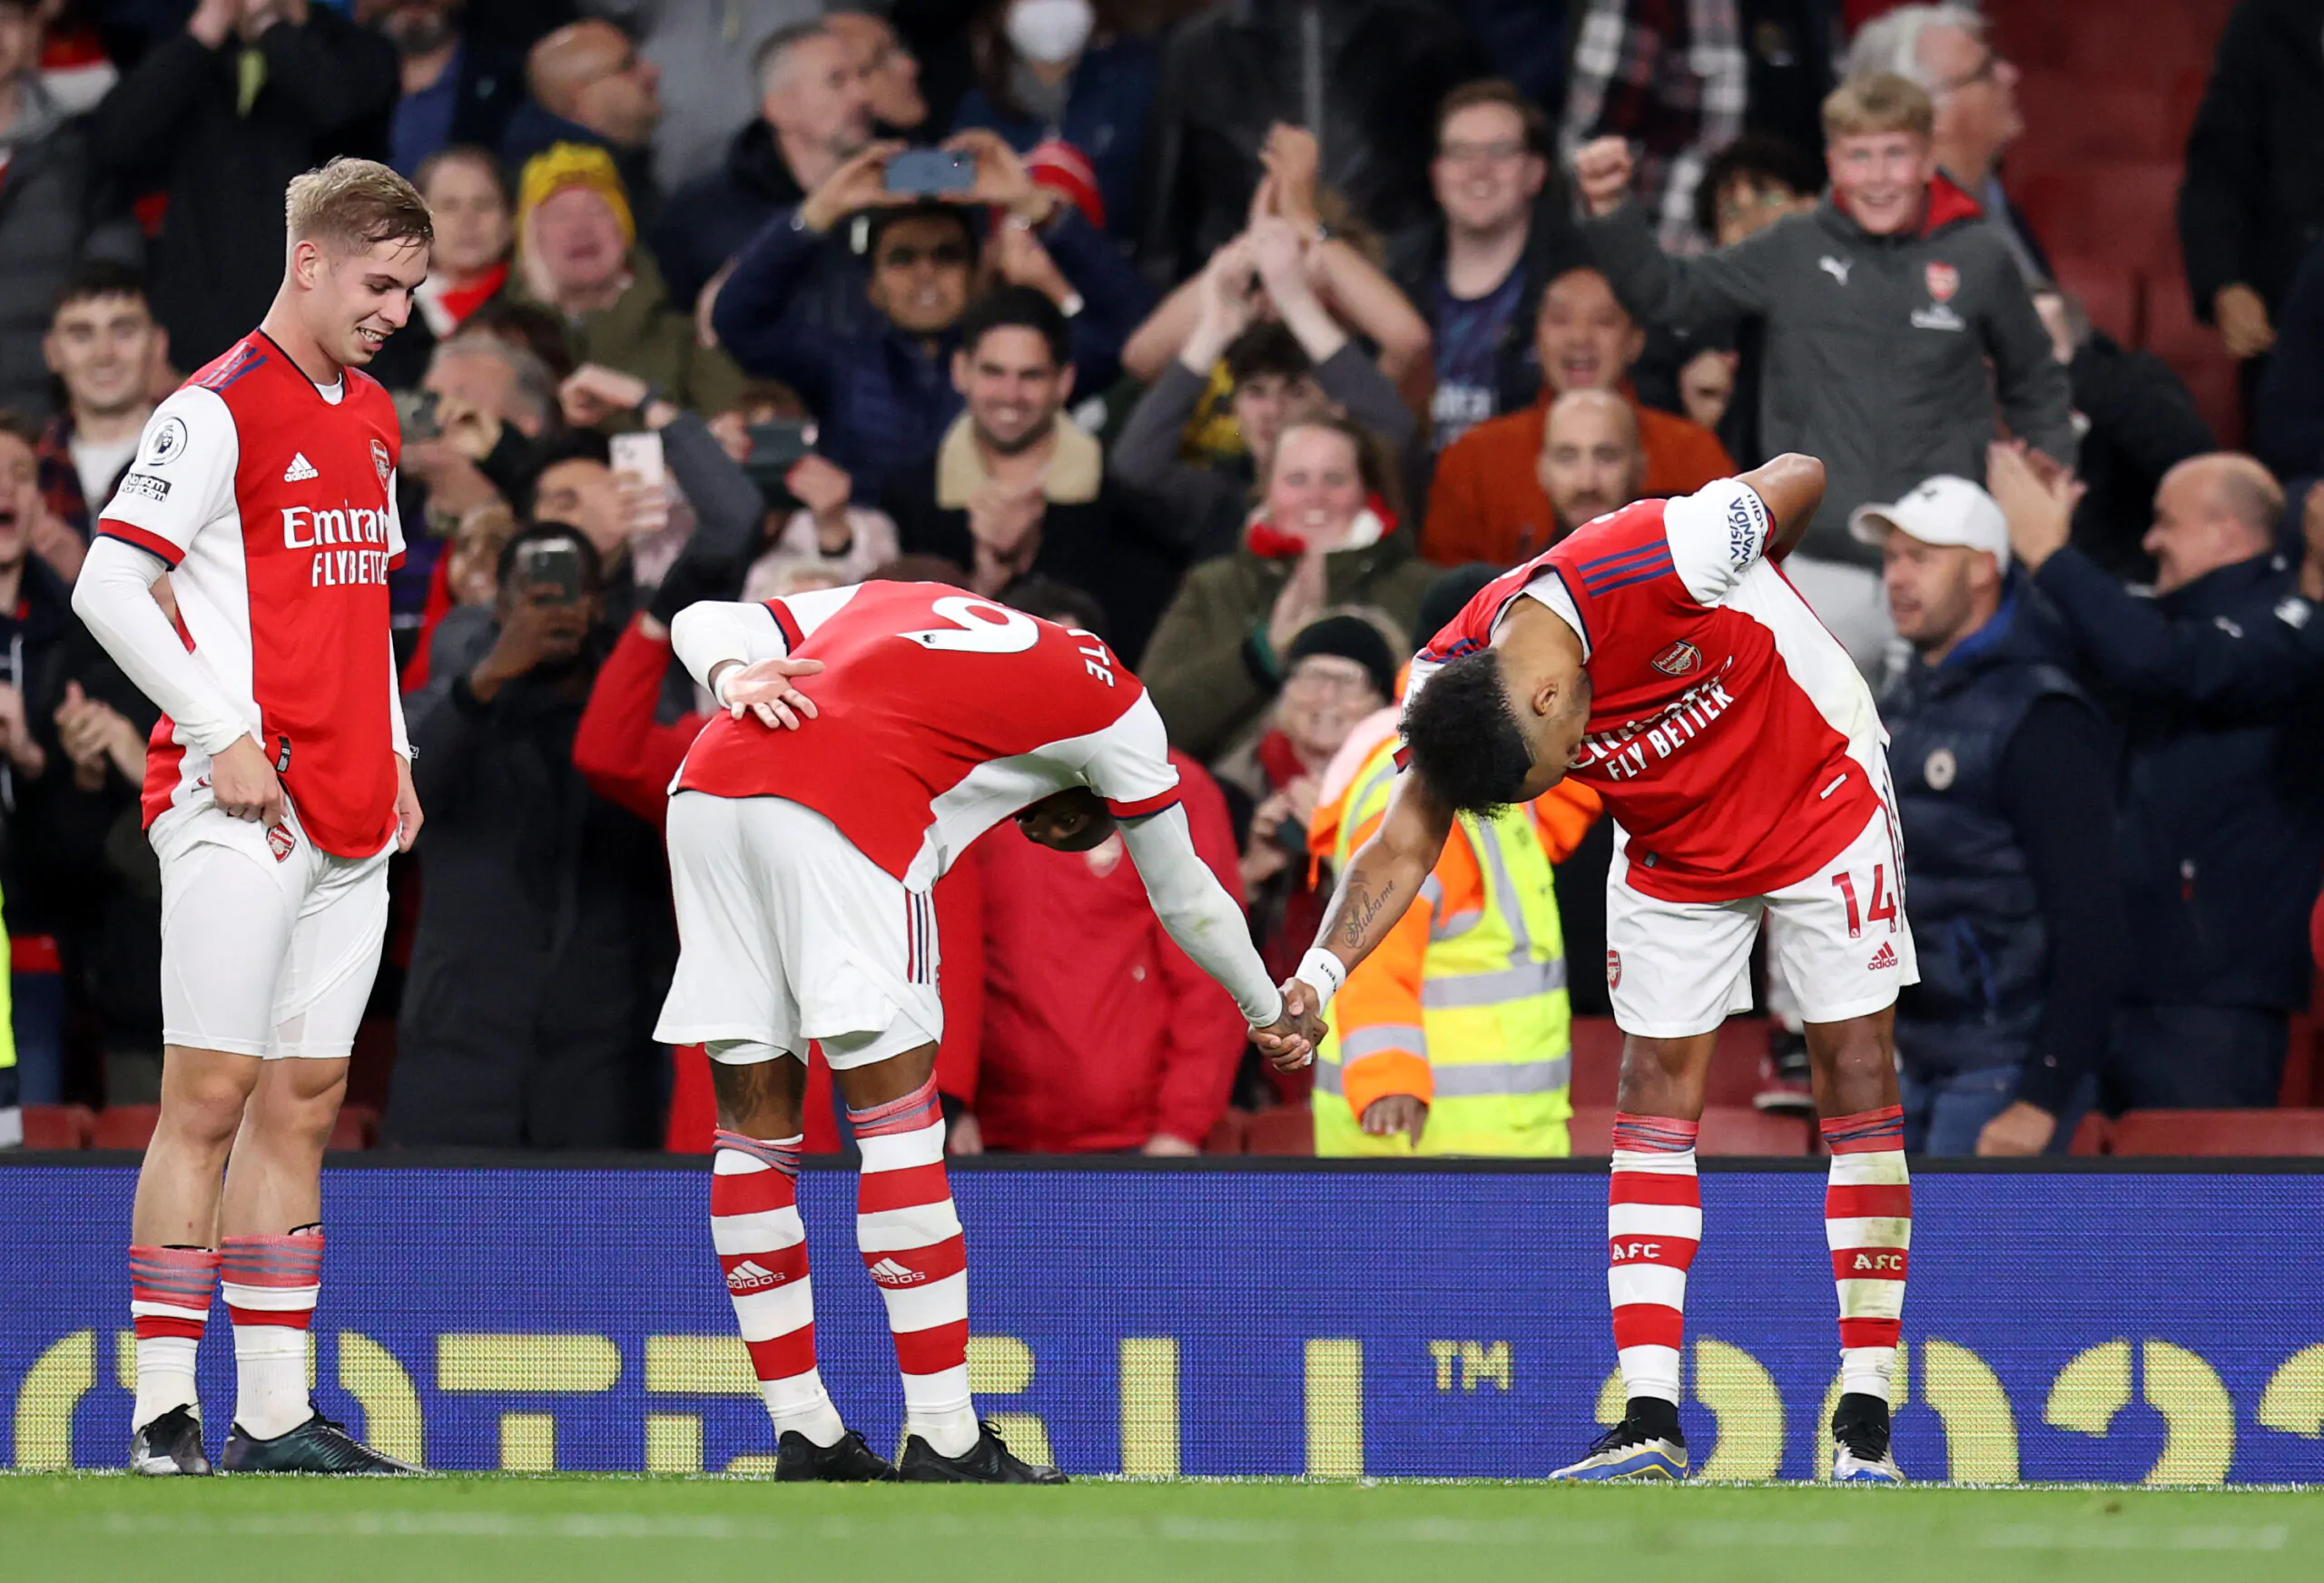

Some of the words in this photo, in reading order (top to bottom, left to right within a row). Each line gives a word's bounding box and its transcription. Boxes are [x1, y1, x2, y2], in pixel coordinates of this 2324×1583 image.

[281, 498, 389, 549] Emirat
[1659, 644, 1686, 667] Arsenal
[1605, 742, 1648, 781] FLY
[1655, 683, 1735, 759] BETTER
[1831, 863, 1896, 939] 14
[1612, 1244, 1661, 1261] AFC
[1853, 1254, 1902, 1271] AFC
